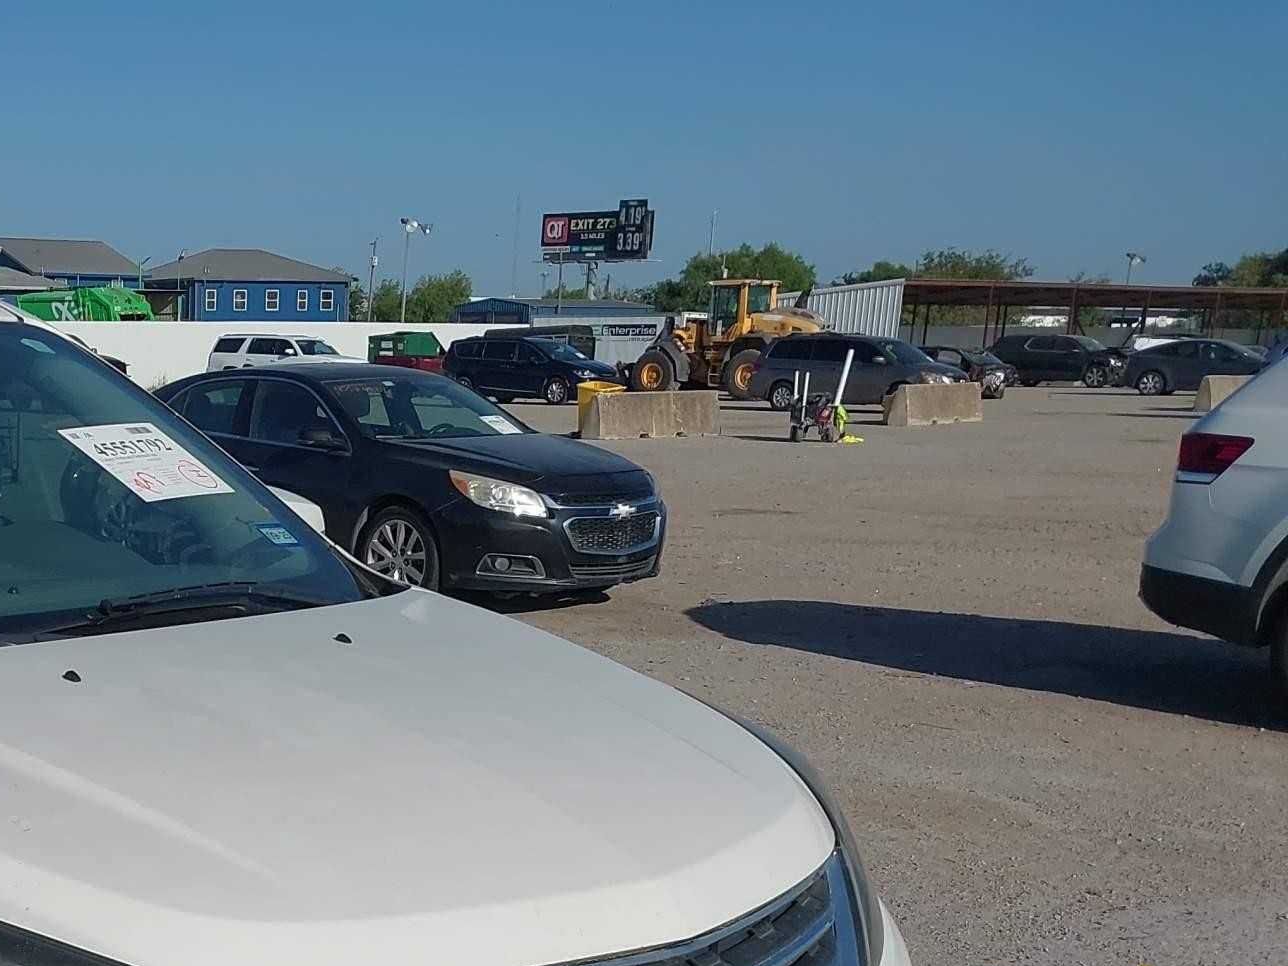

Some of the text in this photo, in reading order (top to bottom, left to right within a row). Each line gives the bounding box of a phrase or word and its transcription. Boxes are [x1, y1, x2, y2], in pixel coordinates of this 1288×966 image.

[546, 221, 565, 239] QT
[570, 218, 595, 230] EXIT
[596, 217, 617, 229] 273
[602, 325, 656, 336] Enterprise
[93, 438, 173, 457] 45551792
